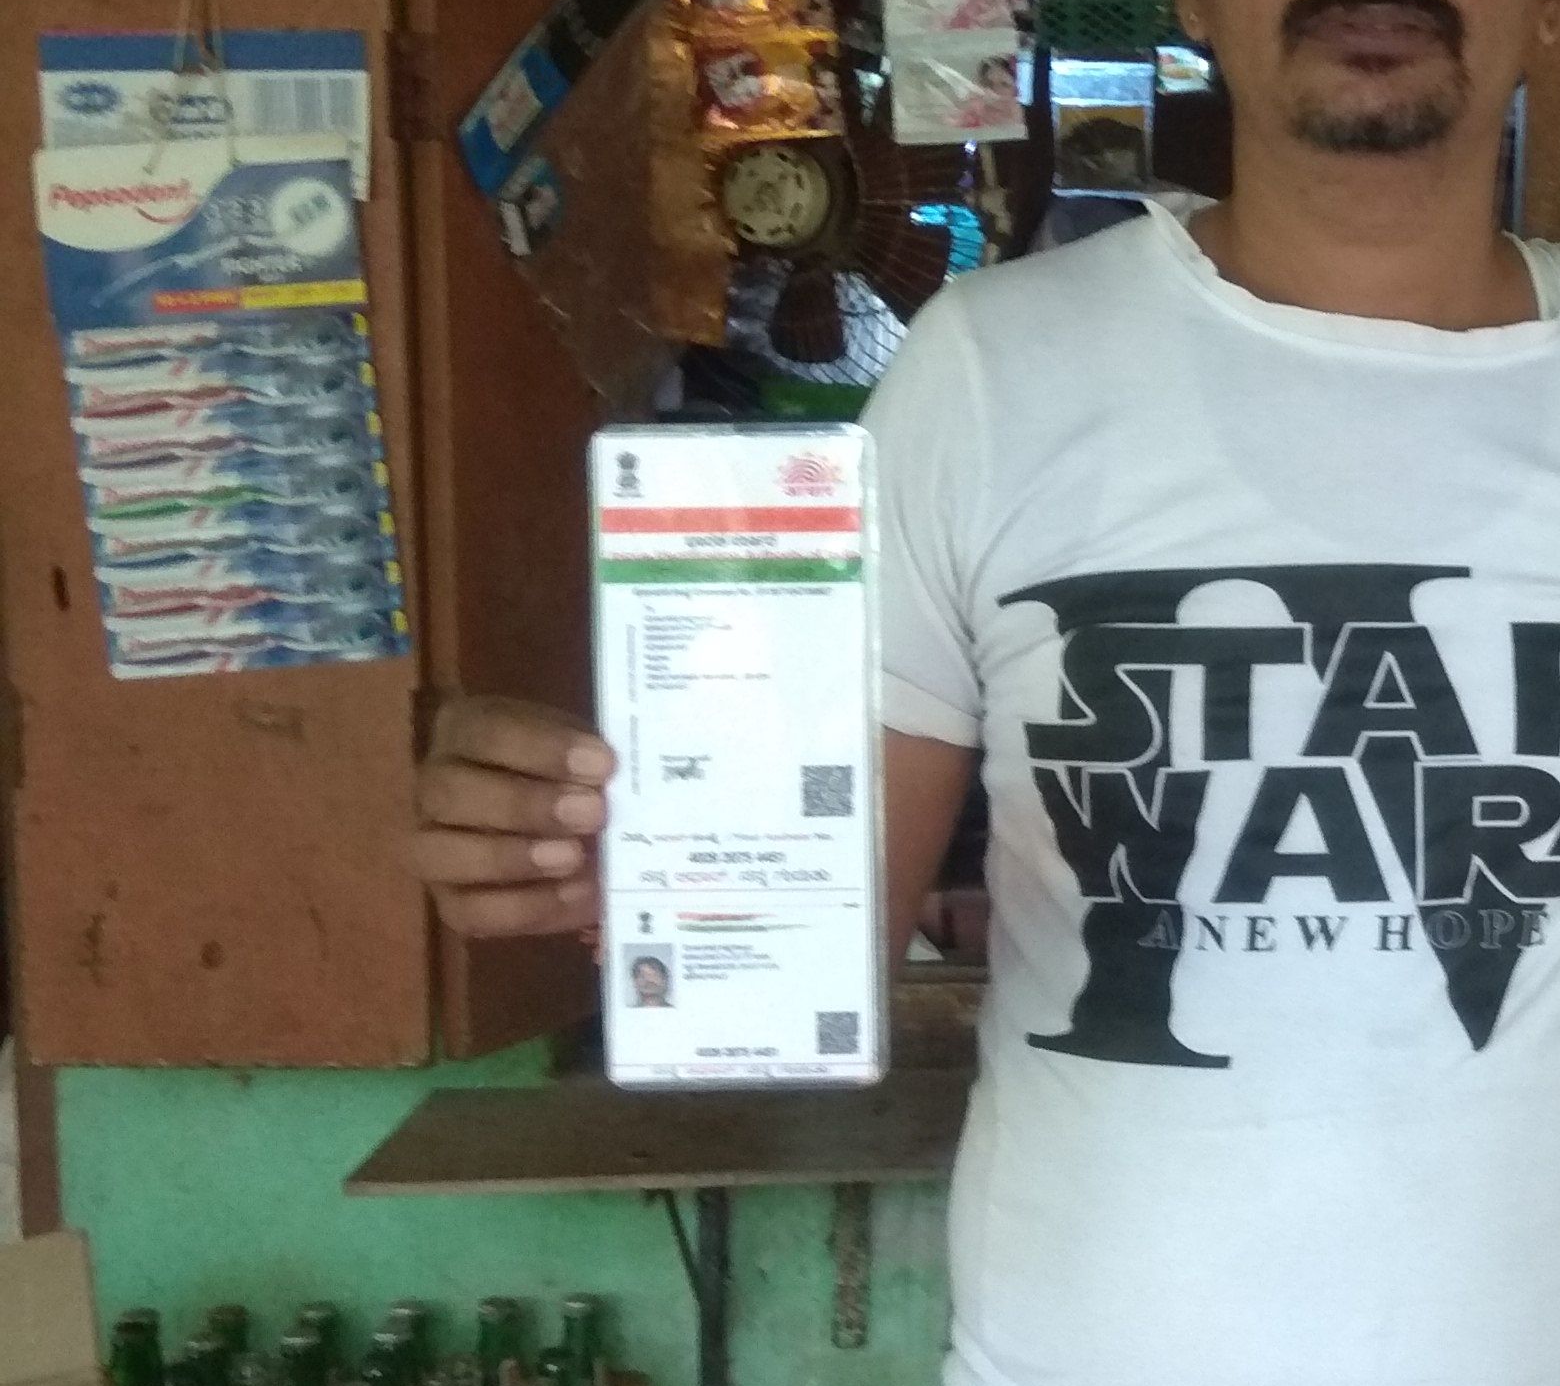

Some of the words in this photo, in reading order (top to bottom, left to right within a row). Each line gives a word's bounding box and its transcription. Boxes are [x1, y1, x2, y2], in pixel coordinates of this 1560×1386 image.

[1137, 910, 1182, 950] A
[1195, 914, 1349, 952] NEW
[1374, 908, 1548, 951] HOPE
